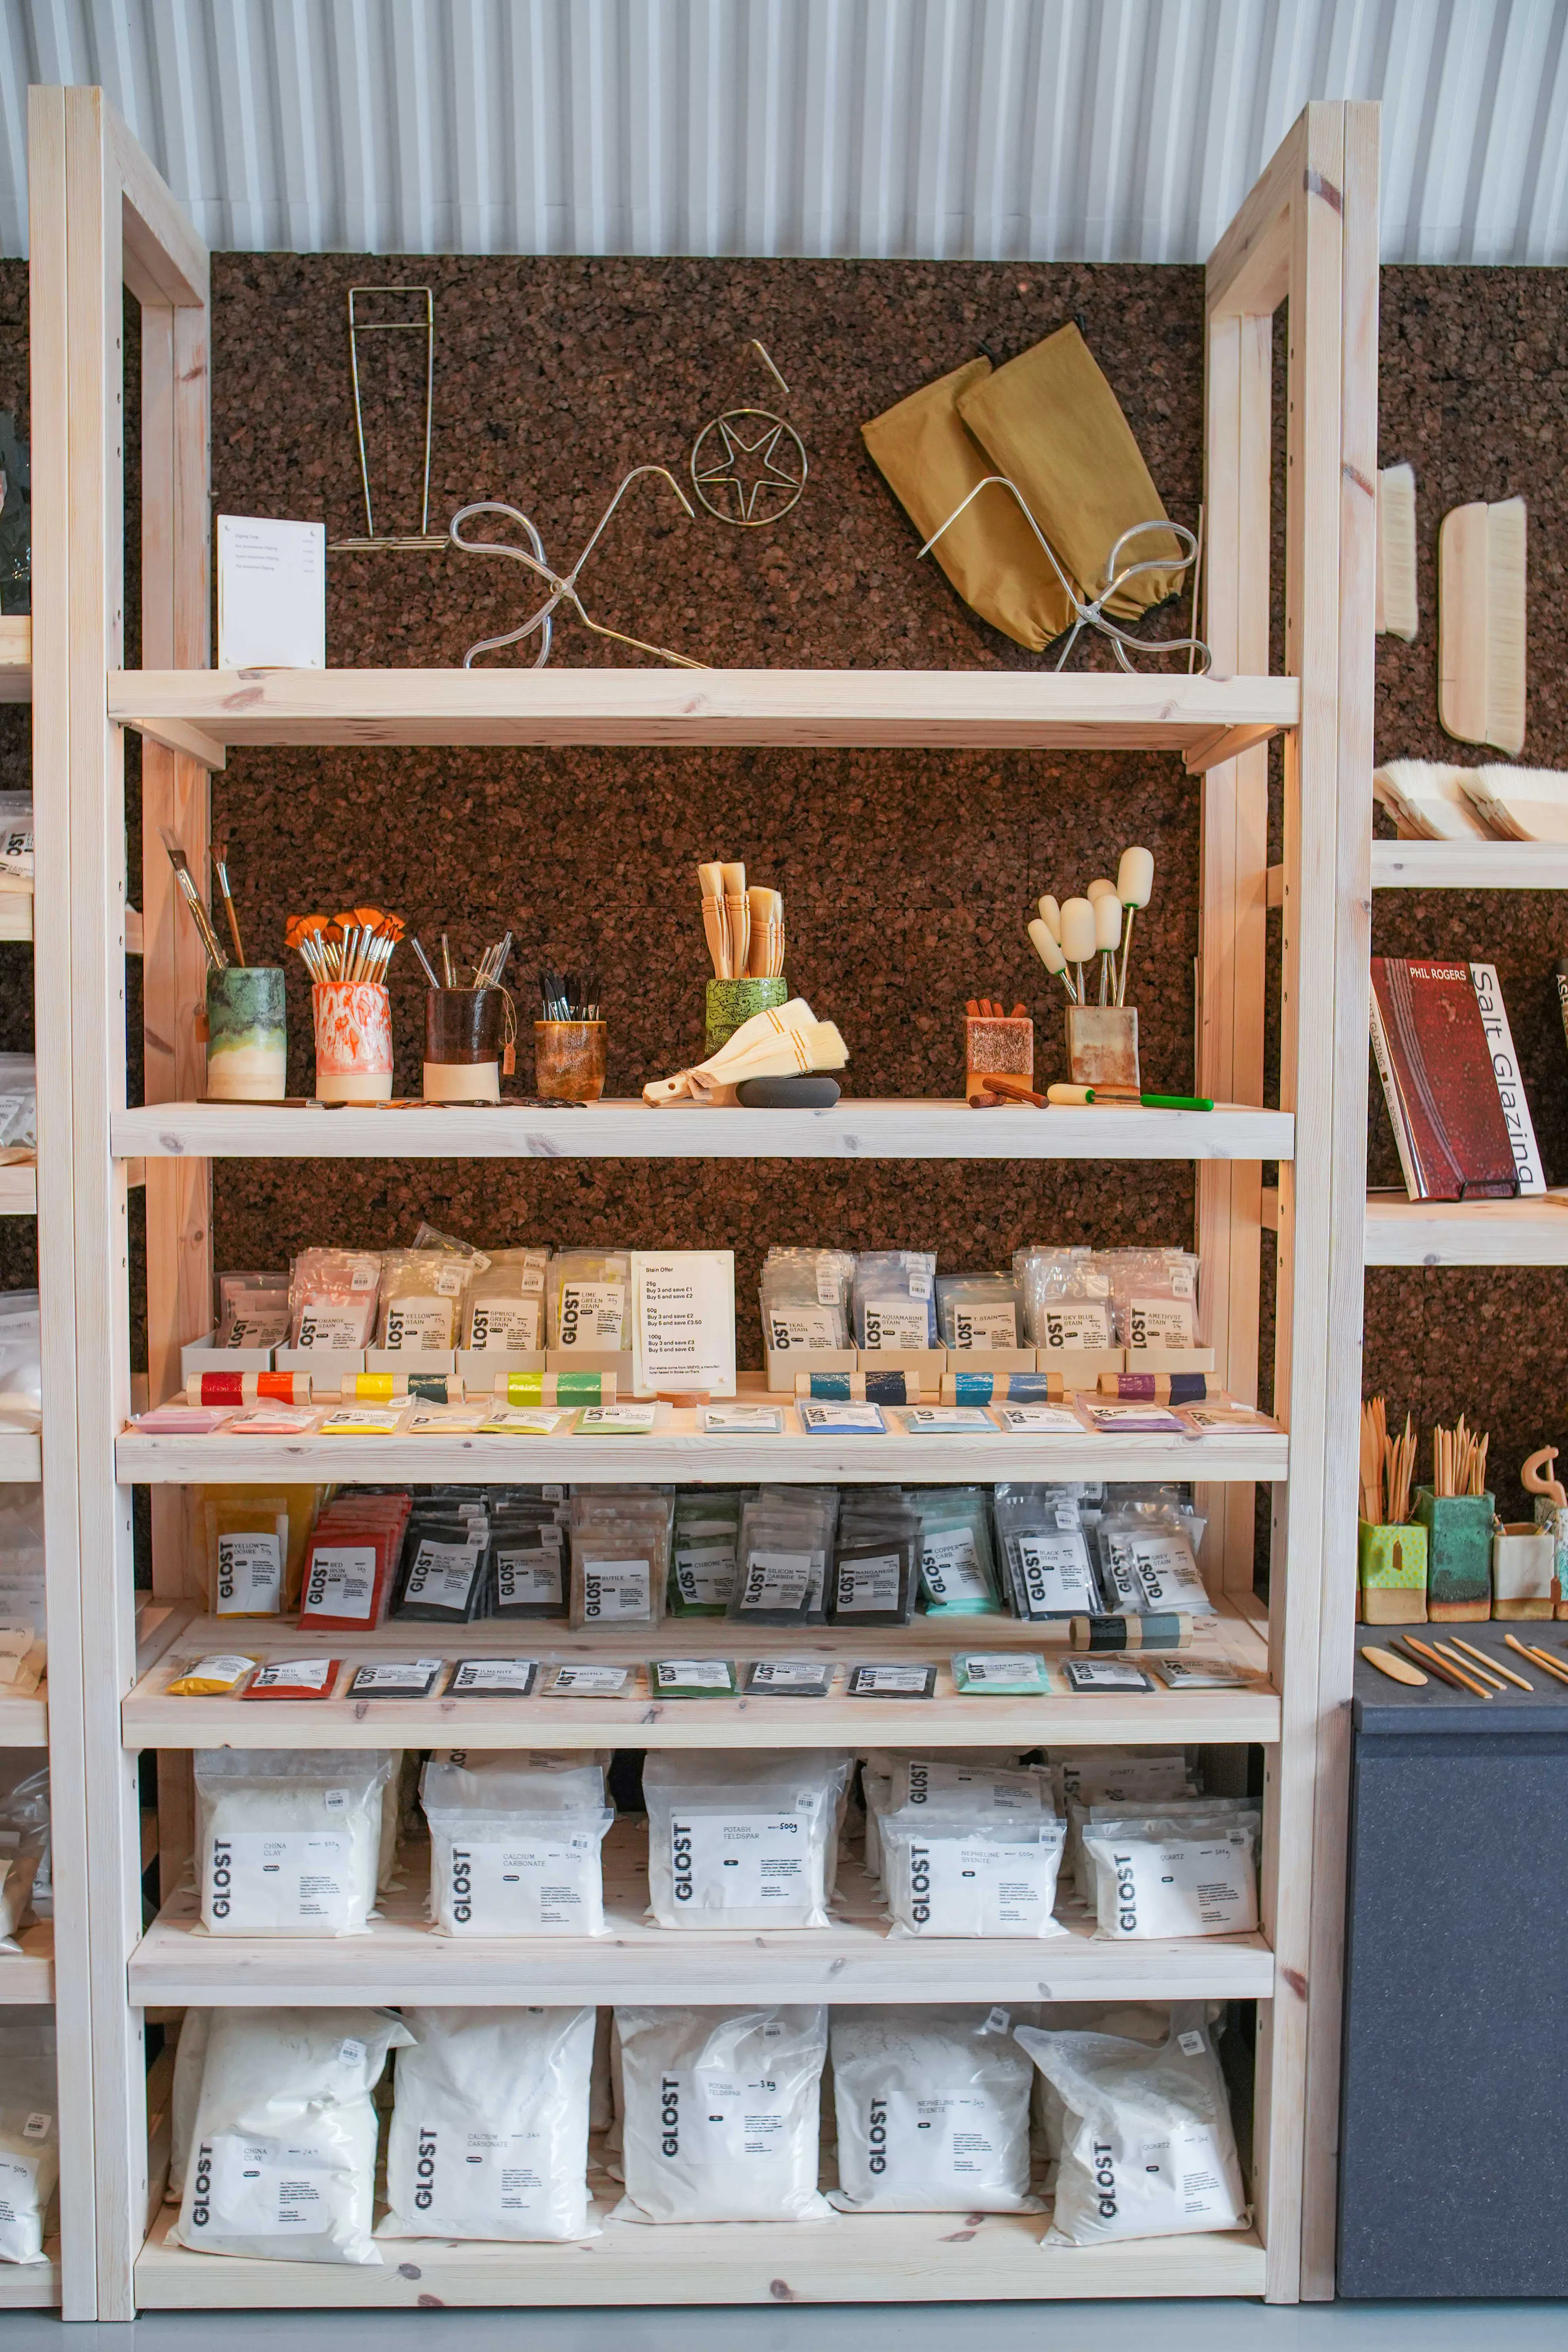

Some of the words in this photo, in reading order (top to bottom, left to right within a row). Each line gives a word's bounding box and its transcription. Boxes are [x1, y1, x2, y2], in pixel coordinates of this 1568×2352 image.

[1410, 967, 1430, 978] PHIL
[1431, 969, 1466, 981] ROGERS
[1472, 971, 1502, 1038] Salt
[1370, 1022, 1385, 1067] GLAZING
[1389, 1106, 1400, 1138] ROGERS
[387, 1309, 404, 1349] LOST
[472, 1308, 489, 1348] LOST
[561, 1289, 580, 1345] GLOST
[867, 1310, 881, 1349] LOST
[1131, 1307, 1147, 1348] LOST
[219, 1541, 234, 1598] GLOST
[410, 1549, 434, 1592] GLOST
[694, 1560, 722, 1569] CHROME
[934, 1545, 960, 1554] COPPER
[1110, 1544, 1132, 1592] GLOST
[309, 1558, 329, 1605] GLOST
[500, 1558, 514, 1596] GLOST
[586, 1572, 601, 1616] GLOST
[678, 1561, 697, 1599] GLOST
[746, 1563, 767, 1603] GLOST
[839, 1568, 856, 1604] GLOST
[1023, 1547, 1046, 1601] GLOST
[1136, 1554, 1163, 1598] GLOST
[457, 1666, 479, 1685] GLOST
[910, 1764, 929, 1804] GLOST
[780, 1822, 798, 1833] 500g
[213, 1838, 232, 1919] GLOST
[674, 1822, 693, 1902] GLOST
[1160, 1853, 1185, 1862] QUARTZ
[453, 1847, 472, 1924] GLOST
[911, 1844, 931, 1924] GLOST
[1113, 1853, 1137, 1932] GLOST
[662, 2077, 680, 2158] GLOST
[917, 2099, 956, 2107] NEPHELINE
[869, 2098, 888, 2175] GLOST
[1143, 2142, 1171, 2152] QUARTZ
[192, 2142, 214, 2228] GLOST
[414, 2126, 438, 2211] GLOST
[1093, 2140, 1119, 2219] GLOST
